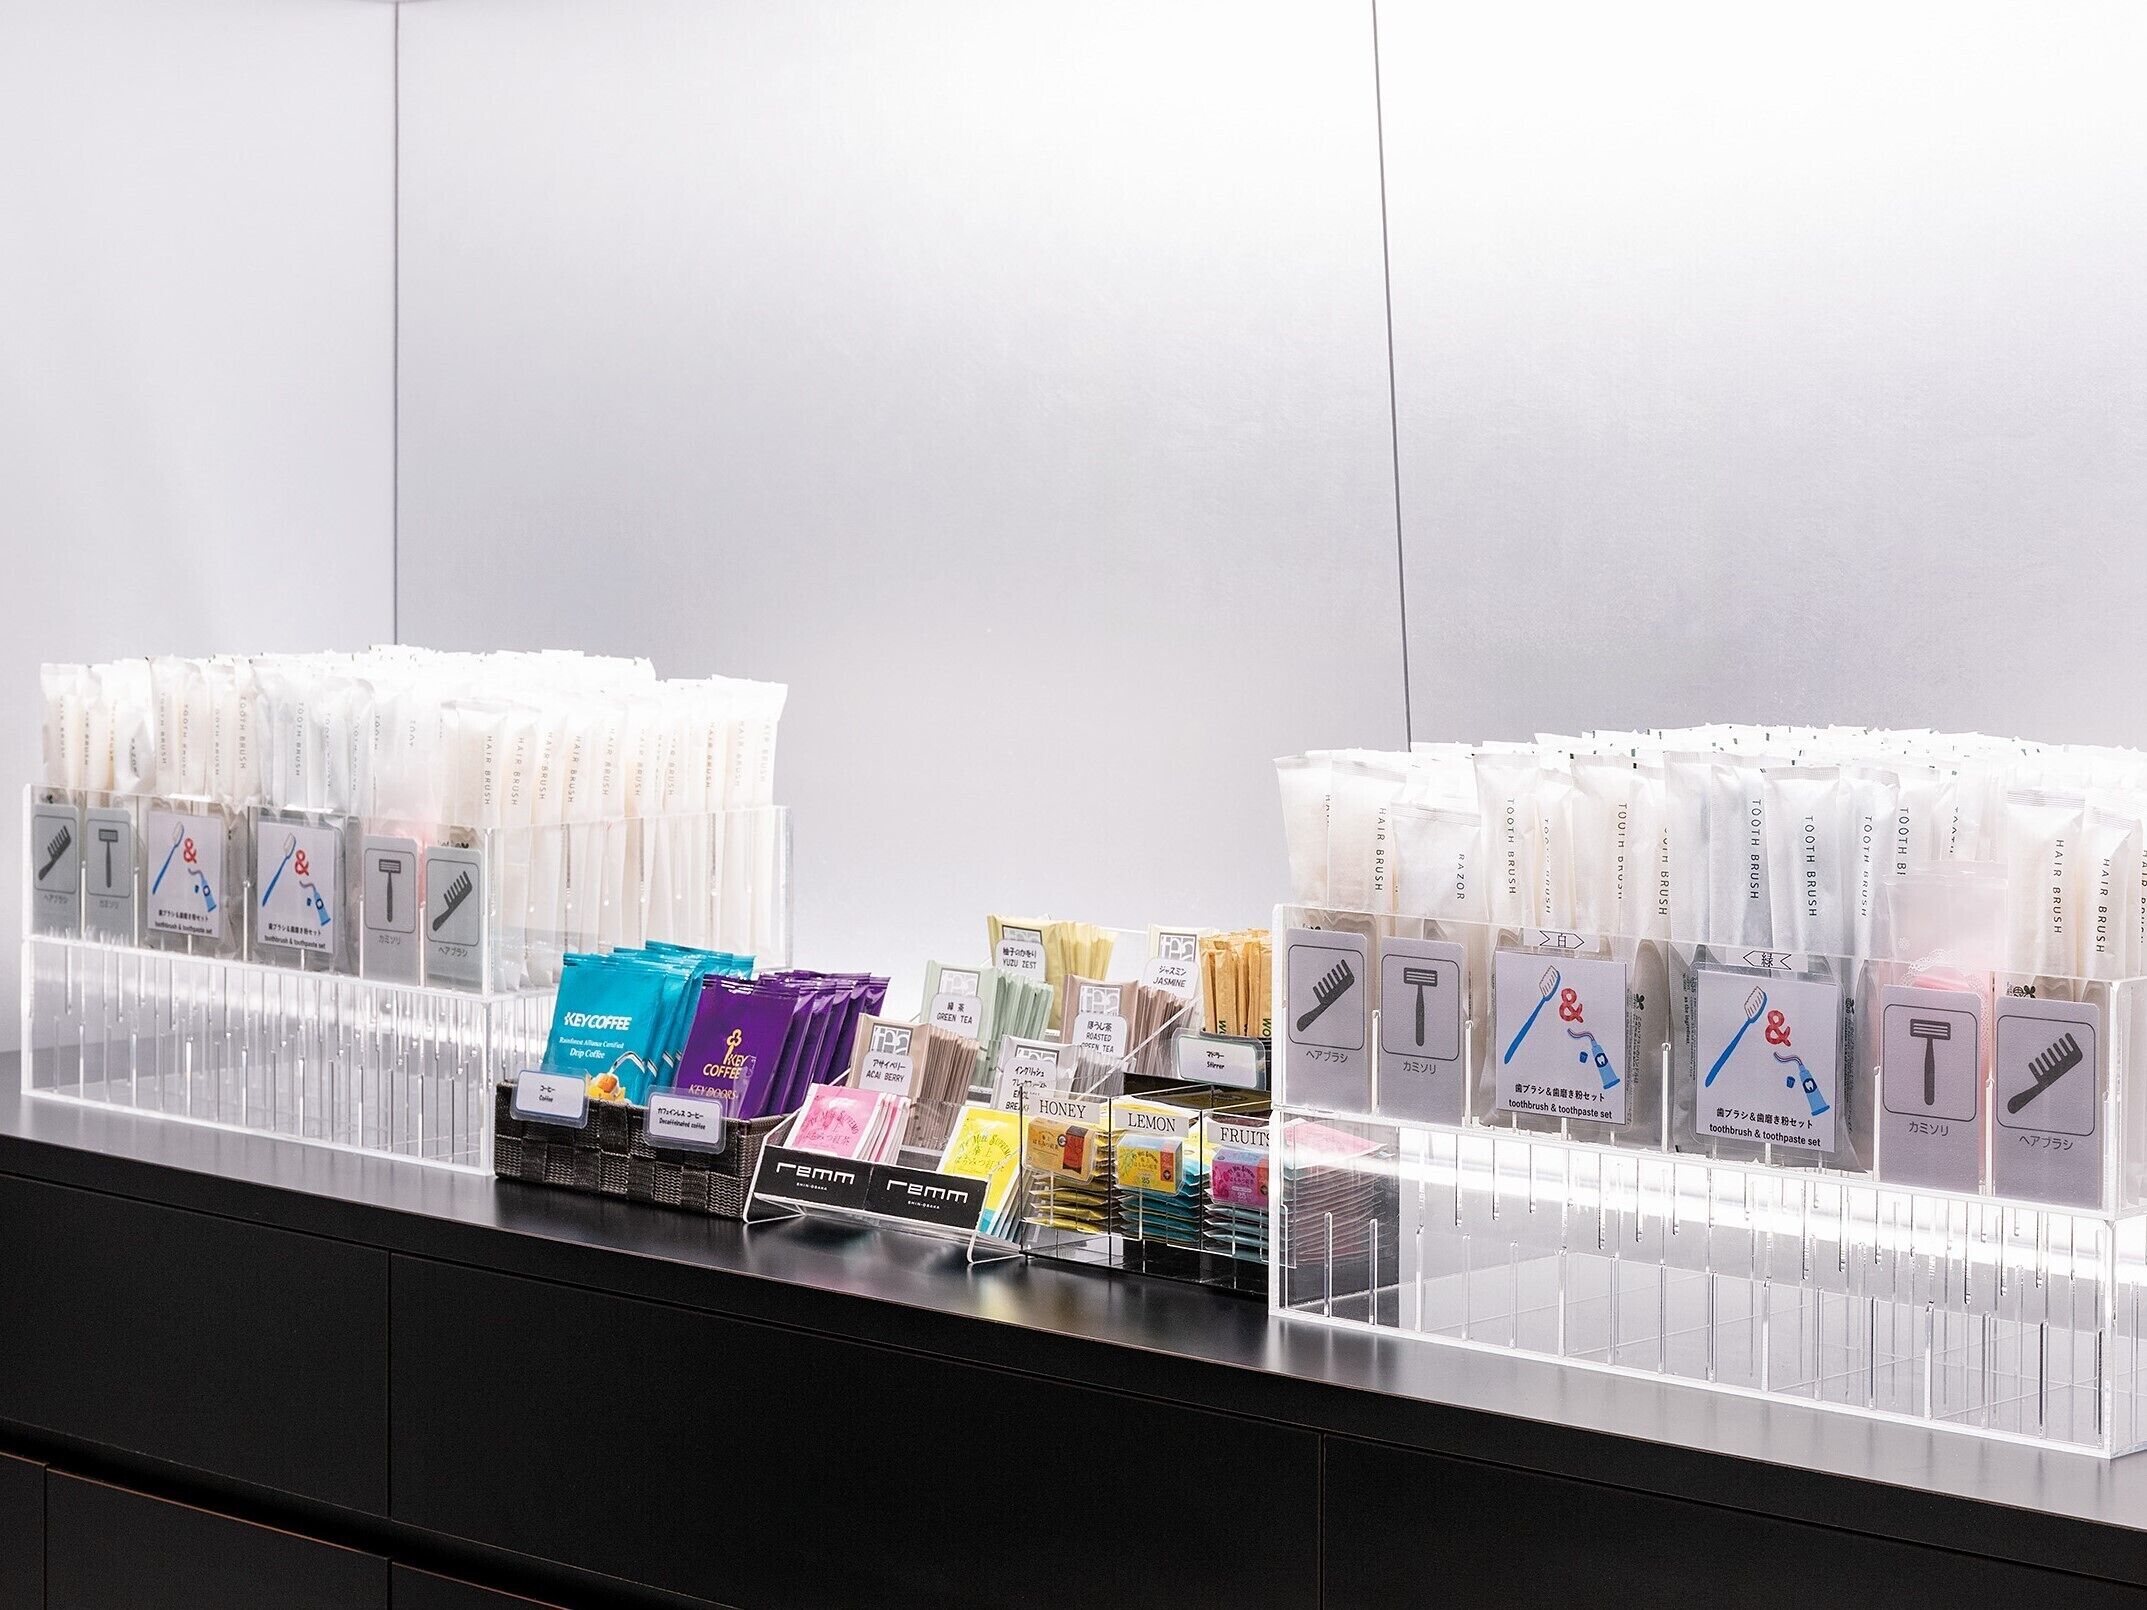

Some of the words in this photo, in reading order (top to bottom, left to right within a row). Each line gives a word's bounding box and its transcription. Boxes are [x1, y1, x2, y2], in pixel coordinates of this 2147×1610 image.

[239, 696, 248, 731] TOOTH
[296, 702, 305, 738] TOOTH
[239, 736, 247, 769] BRUSH
[295, 742, 303, 776] BRUSH
[485, 736, 494, 764] HAIR
[515, 737, 526, 765] HAIR
[572, 736, 582, 762] HAIR
[484, 770, 492, 805] BRUSH
[511, 771, 522, 806] BRUSH
[538, 766, 550, 800] BRUSH
[566, 769, 578, 803] BRUSH
[601, 761, 612, 796] BRUSH
[1375, 808, 1388, 841] HAIR
[1506, 798, 1516, 842] TOOTH
[1750, 799, 1762, 846] TOOTH
[1896, 807, 1910, 854] TOOTH
[183, 838, 198, 864] &
[1804, 816, 1816, 863] TOOTH
[1862, 816, 1874, 863] TOOTH
[294, 850, 310, 876] &
[1374, 849, 1386, 891] BRUSH
[2052, 840, 2066, 877] HAIR
[1455, 853, 1466, 900] RAZOR
[1506, 851, 1518, 894] BRUSH
[1749, 854, 1760, 900] BRUSH
[2099, 858, 2111, 896] HAIR
[1805, 871, 1818, 917] BRUSH
[1860, 871, 1871, 917] BRUSH
[2052, 886, 2064, 934] BRUSH
[264, 935, 288, 945] toothbrush
[294, 938, 318, 949] toothpaste
[378, 935, 401, 946] カミソリ
[2095, 906, 2108, 953] BRUSH
[438, 946, 468, 958] ヘアブラシ
[1002, 958, 1018, 967] YUZU
[1021, 960, 1037, 970] ZEST
[1153, 977, 1186, 988] JASMINE
[1159, 965, 1187, 977] ジャスミン
[937, 1012, 956, 1022] GREEN
[960, 1015, 972, 1024] TEA
[1559, 987, 1584, 1024] &
[1086, 1031, 1112, 1042] ROASTED
[1764, 1009, 1792, 1047] &
[569, 1048, 584, 1059] Drip
[585, 1049, 606, 1059] Coffee
[603, 1040, 625, 1049] Certified
[1102, 1044, 1114, 1053] TEA
[1305, 1050, 1349, 1063] ヘアブラシ
[702, 1063, 742, 1080] COFFEE
[727, 1054, 749, 1067] KEY
[1403, 1061, 1437, 1075] カミソリ
[540, 1085, 555, 1093] コーヒー
[866, 1070, 882, 1080] ACAI
[884, 1072, 905, 1083] BERRY
[538, 1095, 553, 1103] Coffee
[688, 1084, 706, 1096] KEY
[687, 1111, 704, 1119] コーヒー
[1040, 1099, 1086, 1119] HONEY
[1128, 1112, 1175, 1132] LEMON
[1508, 1099, 1549, 1112] toothbrush
[1550, 1103, 1557, 1112] &
[1558, 1105, 1599, 1117] toothpaste
[1600, 1110, 1613, 1119] set
[691, 1122, 706, 1130] coffee
[1709, 1123, 1752, 1137] toothbrush
[1754, 1129, 1761, 1138] &
[1762, 1131, 1806, 1144] toothpaste
[1807, 1138, 1821, 1147] set
[1908, 1121, 1949, 1137] カミソリ
[776, 1161, 855, 1185] remm
[886, 1179, 968, 1204] remm
